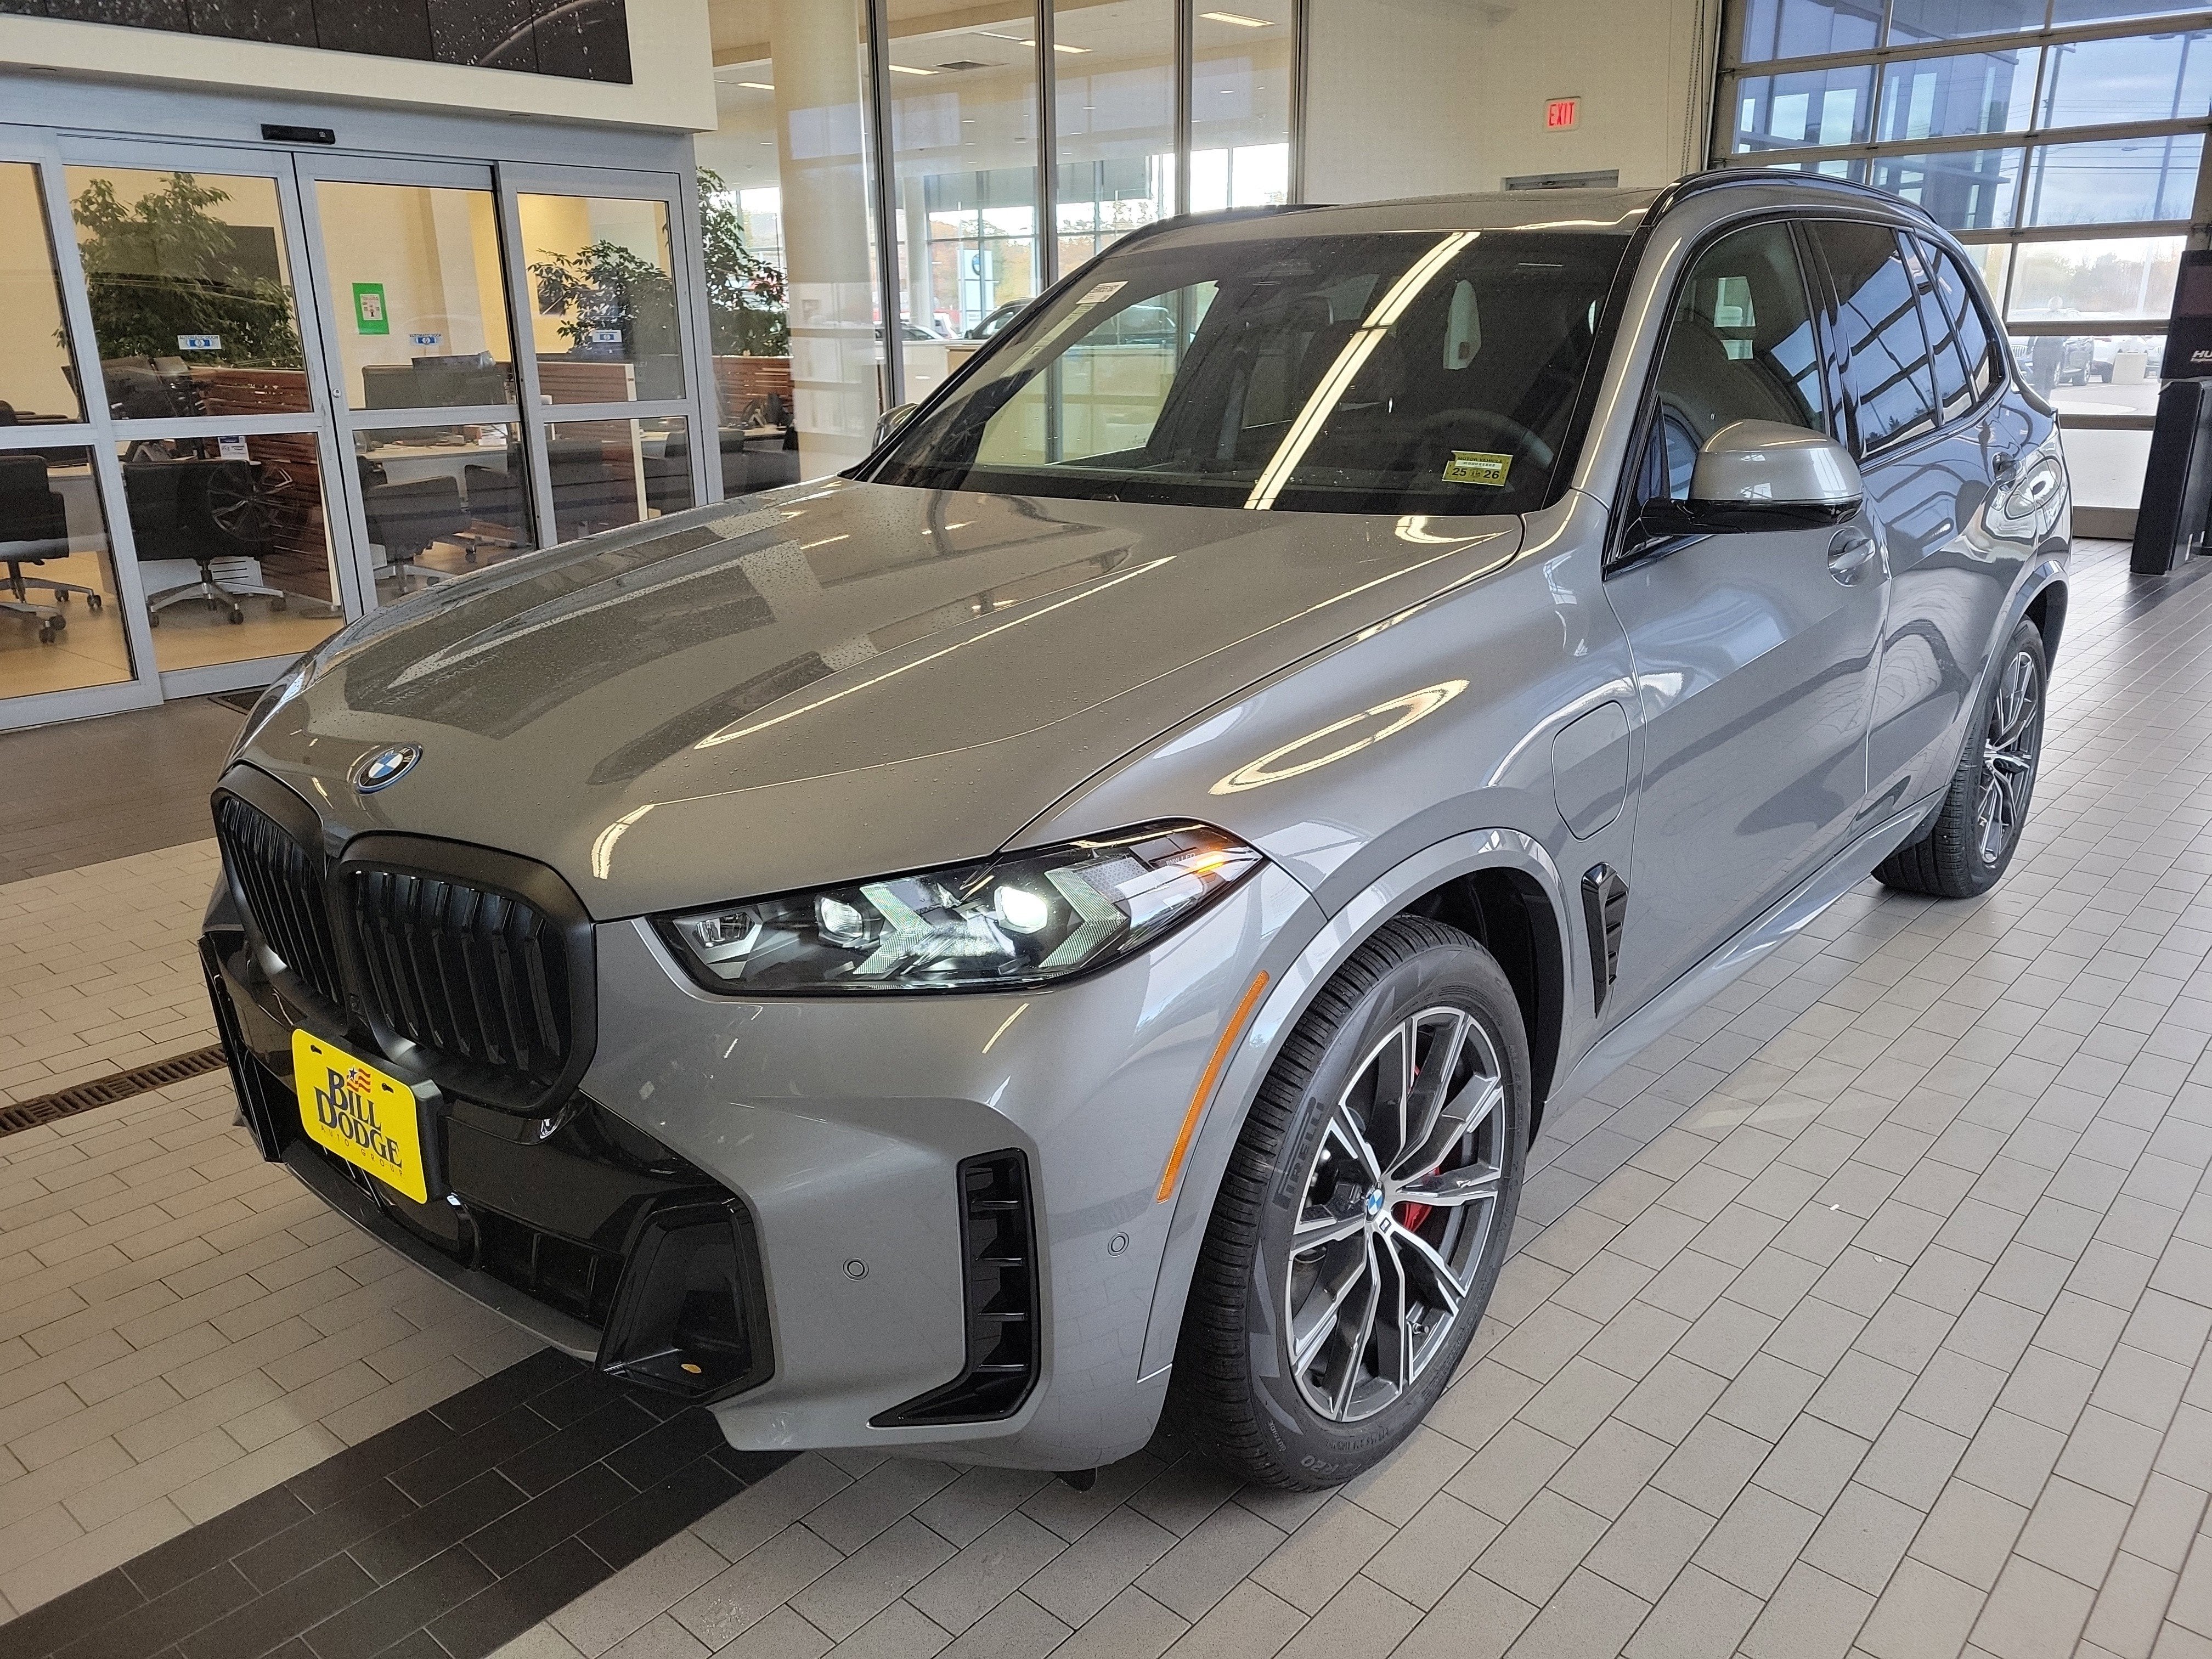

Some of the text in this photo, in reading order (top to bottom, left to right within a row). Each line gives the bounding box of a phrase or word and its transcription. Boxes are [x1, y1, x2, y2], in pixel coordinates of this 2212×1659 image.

[1549, 102, 1575, 126] EXIT
[1451, 467, 1500, 479] 25 26
[1166, 857, 1180, 866] BMW
[326, 1066, 382, 1132] BILL
[313, 1085, 403, 1169] DODGE
[321, 1125, 403, 1177] AUTO GROUP
[1272, 1097, 1325, 1211] PIRELLI
[1267, 1419, 1286, 1452] OUTSIDE
